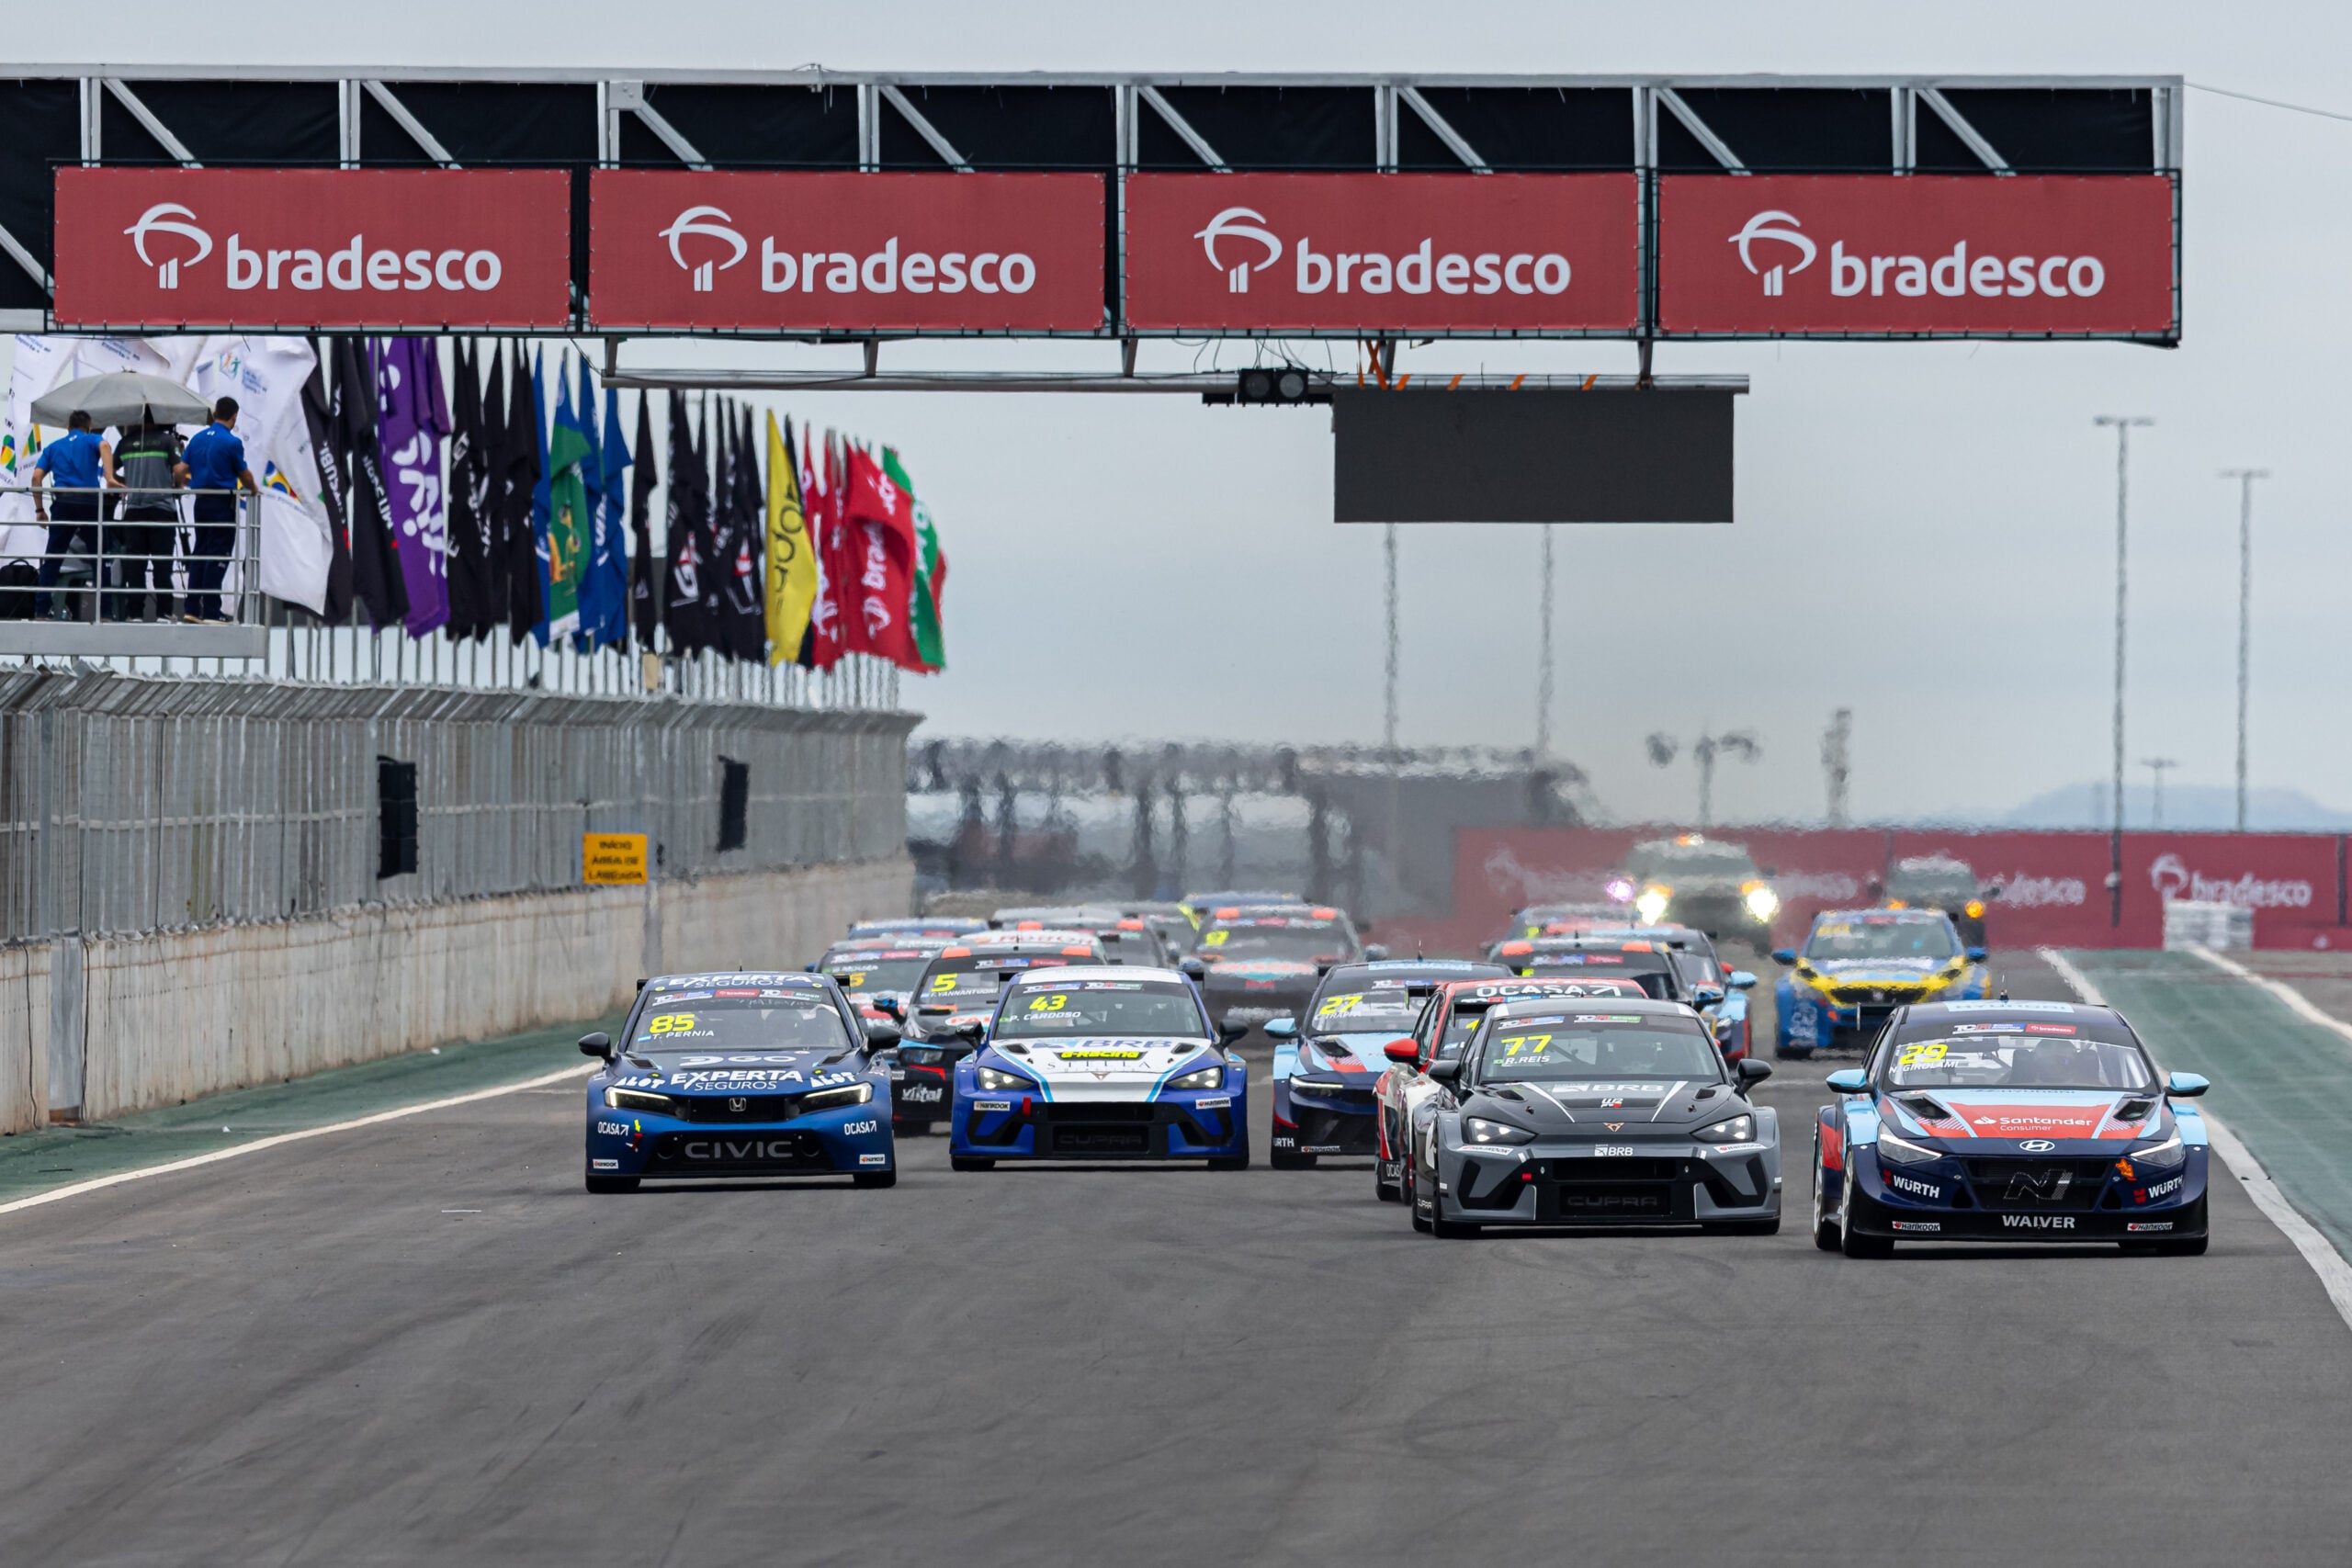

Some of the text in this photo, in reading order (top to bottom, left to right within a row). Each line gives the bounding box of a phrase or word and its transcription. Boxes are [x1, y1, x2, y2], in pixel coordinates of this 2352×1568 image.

[227, 233, 502, 291] bradesco
[762, 236, 1036, 294] bradesco
[1296, 237, 1571, 295] bradesco
[1831, 241, 2105, 297] bradesco
[2007, 873, 2086, 906] desco
[2190, 872, 2312, 907] bradesco
[669, 975, 812, 987] EXPERTA
[695, 979, 783, 987] SEGUROS
[931, 974, 957, 992] 5
[1476, 985, 1587, 998] OCASA
[1029, 995, 1068, 1011] 43
[1318, 996, 1363, 1015] 27
[649, 1014, 695, 1033] 85
[1023, 1011, 1081, 1021] CARDOSO
[666, 1031, 715, 1039] PERNIA
[1082, 1040, 1171, 1048] BRB
[1500, 1034, 1553, 1056] 77
[1898, 1044, 1949, 1065] 29
[1903, 1059, 1960, 1072] GIROLAMI
[671, 1070, 803, 1089] EXPERTA
[694, 1080, 777, 1091] SEGUROS
[598, 1121, 620, 1135] OCASA
[843, 1121, 870, 1135] OCASA
[1999, 1116, 2093, 1126] Santander
[1059, 1134, 1142, 1145] CUPRA
[684, 1141, 793, 1158] CIVIC
[1608, 1146, 1634, 1156] BRB
[1385, 1163, 1401, 1178] OCAS
[1567, 1197, 1657, 1206] CUPRA
[2002, 1214, 2075, 1229] WAIVER
